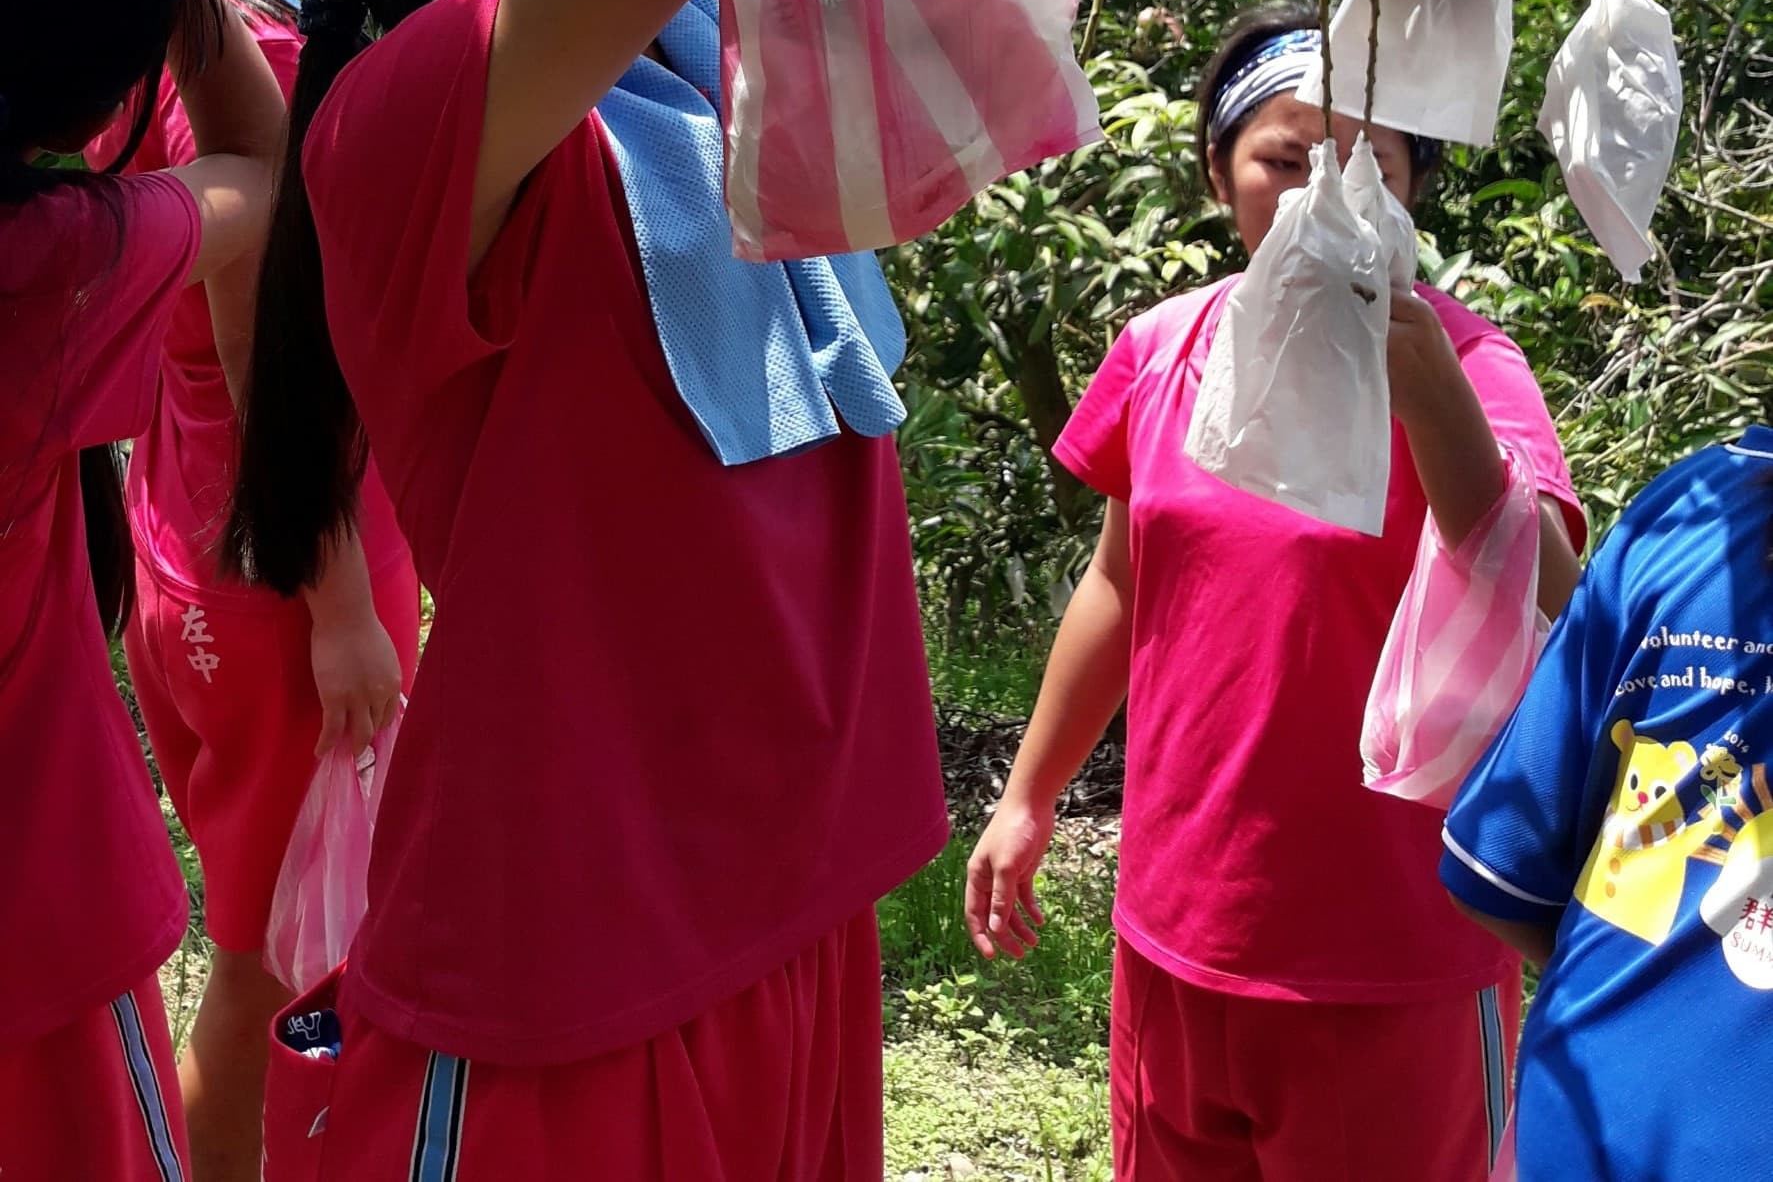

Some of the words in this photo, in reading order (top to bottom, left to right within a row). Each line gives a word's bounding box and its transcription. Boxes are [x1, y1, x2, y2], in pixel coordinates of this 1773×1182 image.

[180, 603, 220, 684] 左中
[1661, 666, 1693, 688] and
[1700, 666, 1756, 696] hope,
